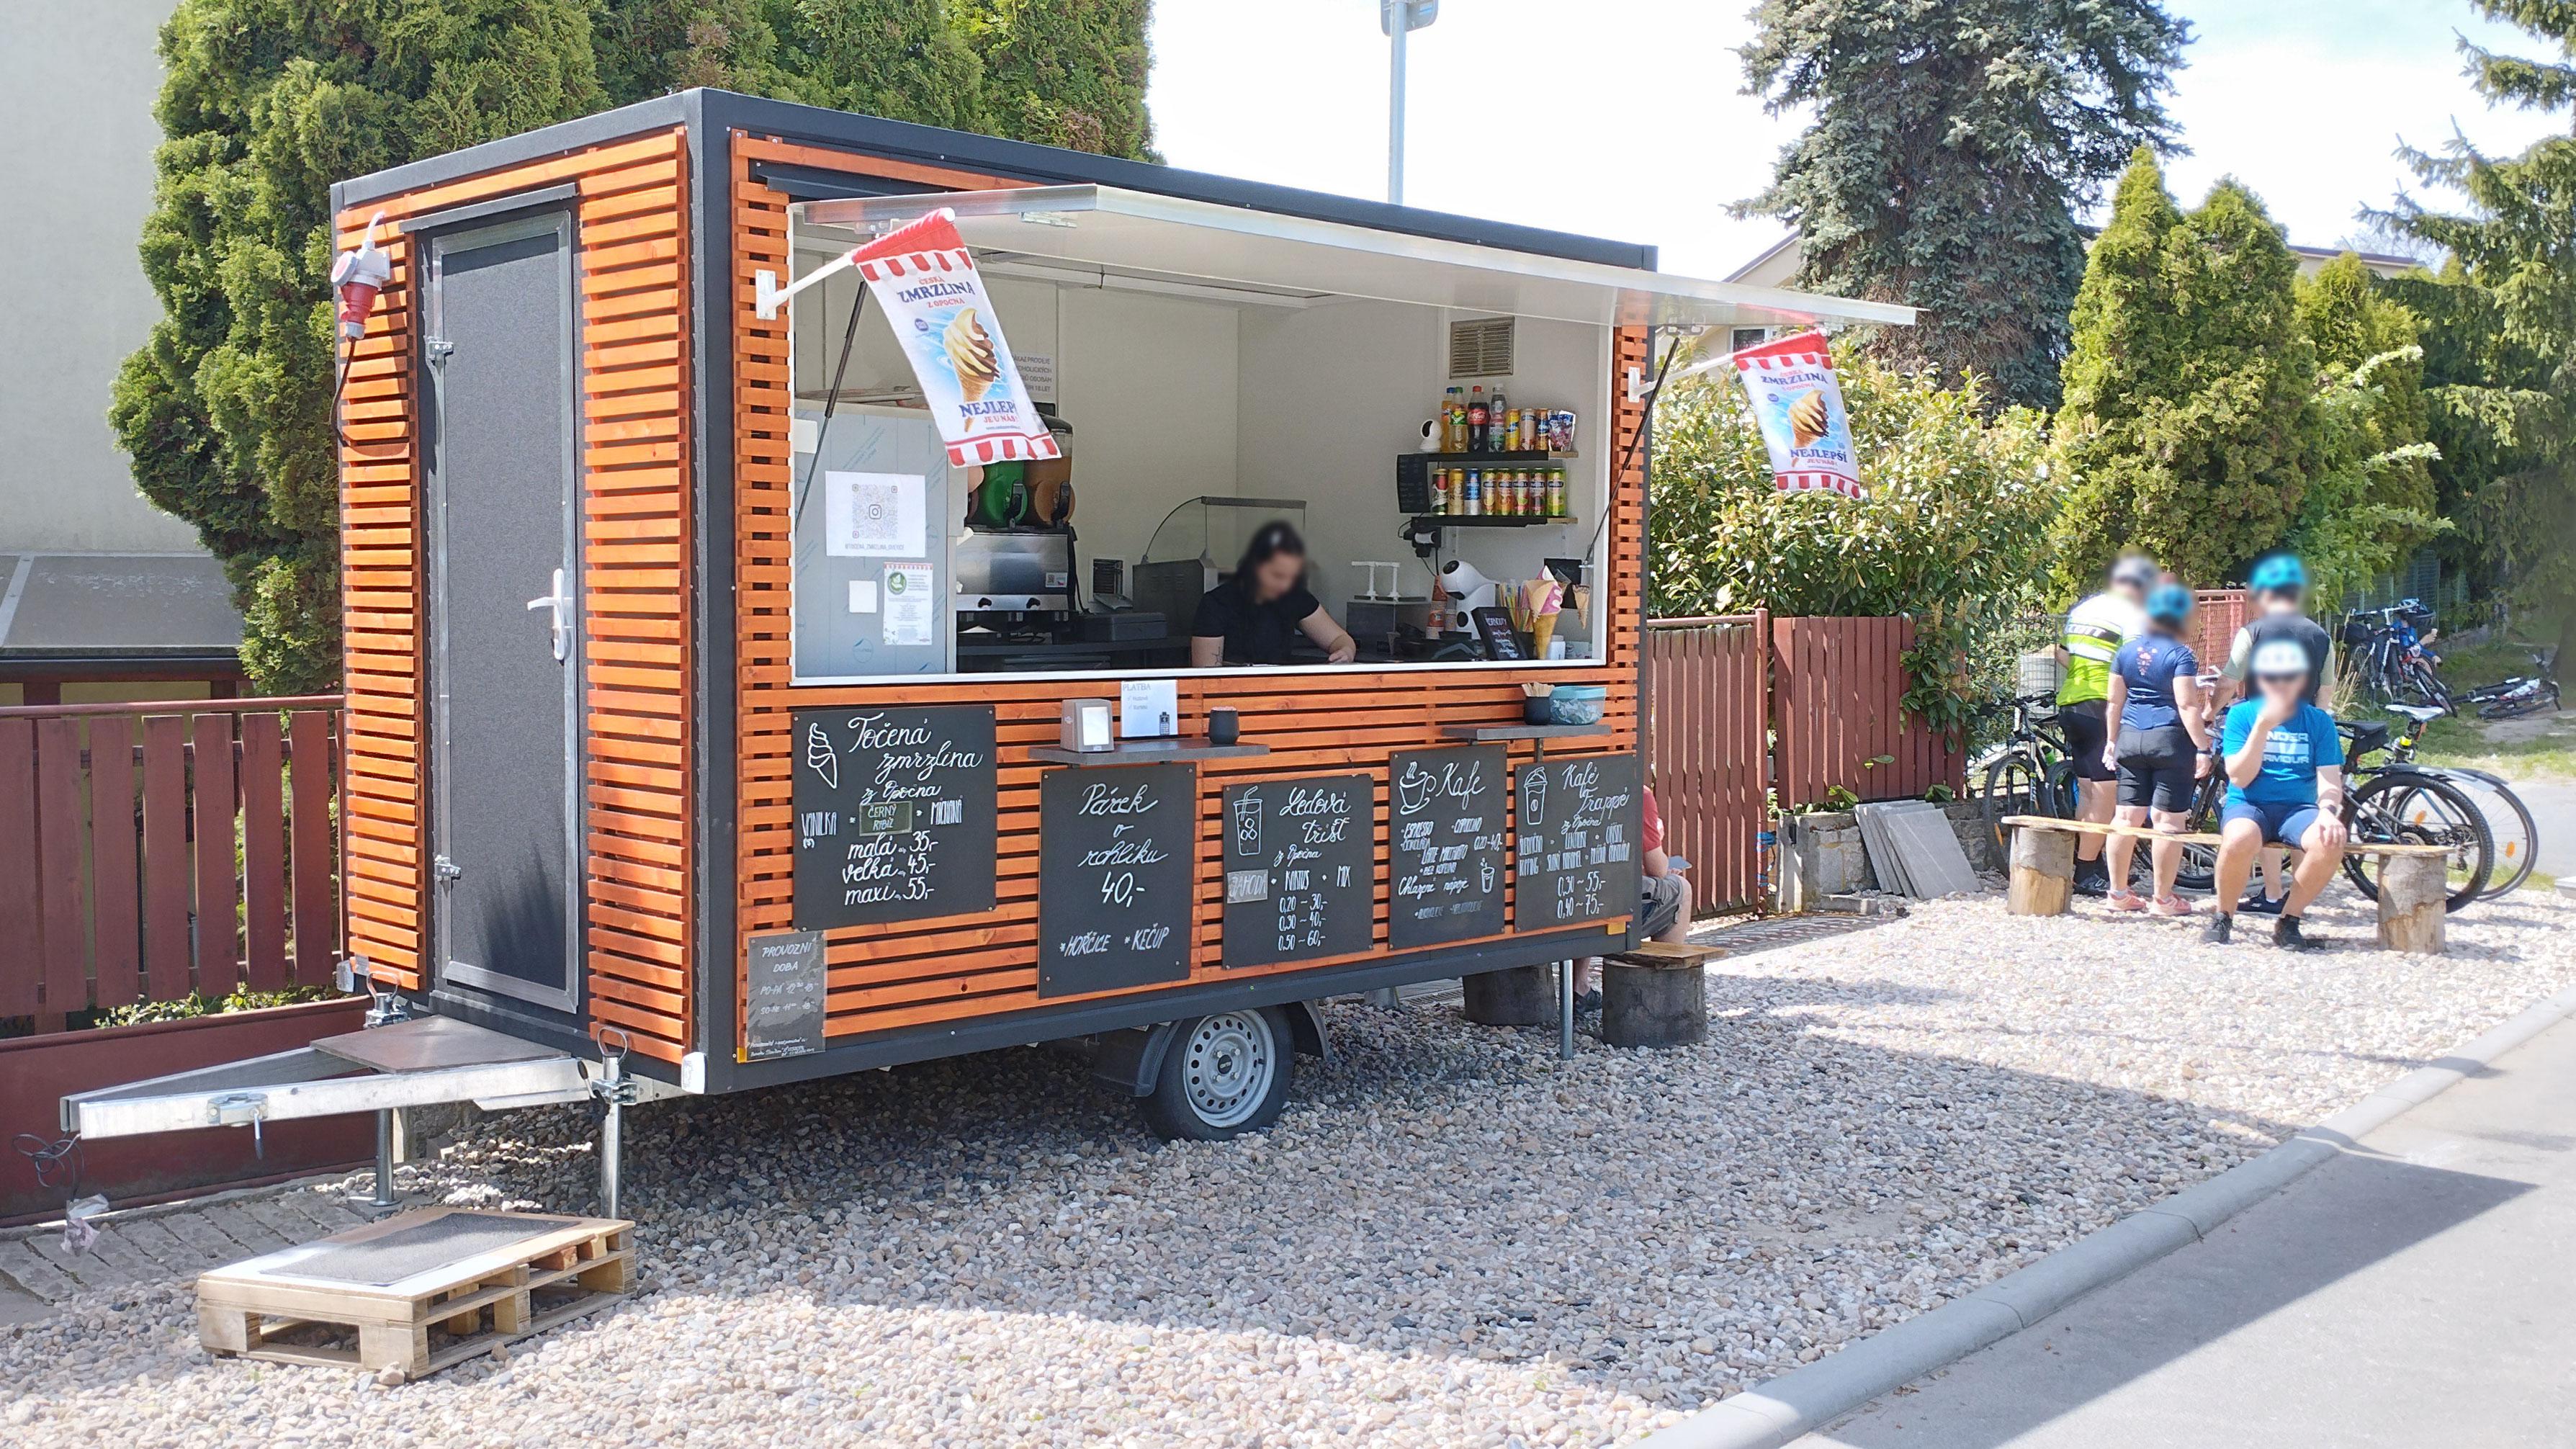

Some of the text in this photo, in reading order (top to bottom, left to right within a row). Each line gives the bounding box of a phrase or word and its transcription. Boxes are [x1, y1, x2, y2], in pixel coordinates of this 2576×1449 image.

[897, 281, 976, 302] ZMRZLINA
[1760, 372, 1828, 385] ZMRZLINA
[959, 400, 1015, 418] NEJLEP
[1790, 449, 1848, 463] NEJLEPŠÍ
[848, 712, 932, 753] Točená
[2266, 731, 2309, 742] NDER
[875, 740, 984, 784] zmrzlina
[2262, 754, 2309, 763] RMOUR
[1079, 783, 1158, 815] Párek
[1279, 786, 1351, 816] Ledová
[1577, 787, 1630, 820] Frappé
[867, 804, 897, 819] ČERNÝ
[801, 811, 837, 837] VANILKA
[848, 833, 898, 860] malá
[1078, 838, 1168, 867] rohlíku
[842, 857, 899, 884] velká
[1336, 865, 1351, 887] MIX
[844, 882, 896, 906] maxi
[762, 937, 816, 958] PROVOZNÍ
[1131, 923, 1170, 951] KEČUP
[773, 961, 799, 973] DOBA
